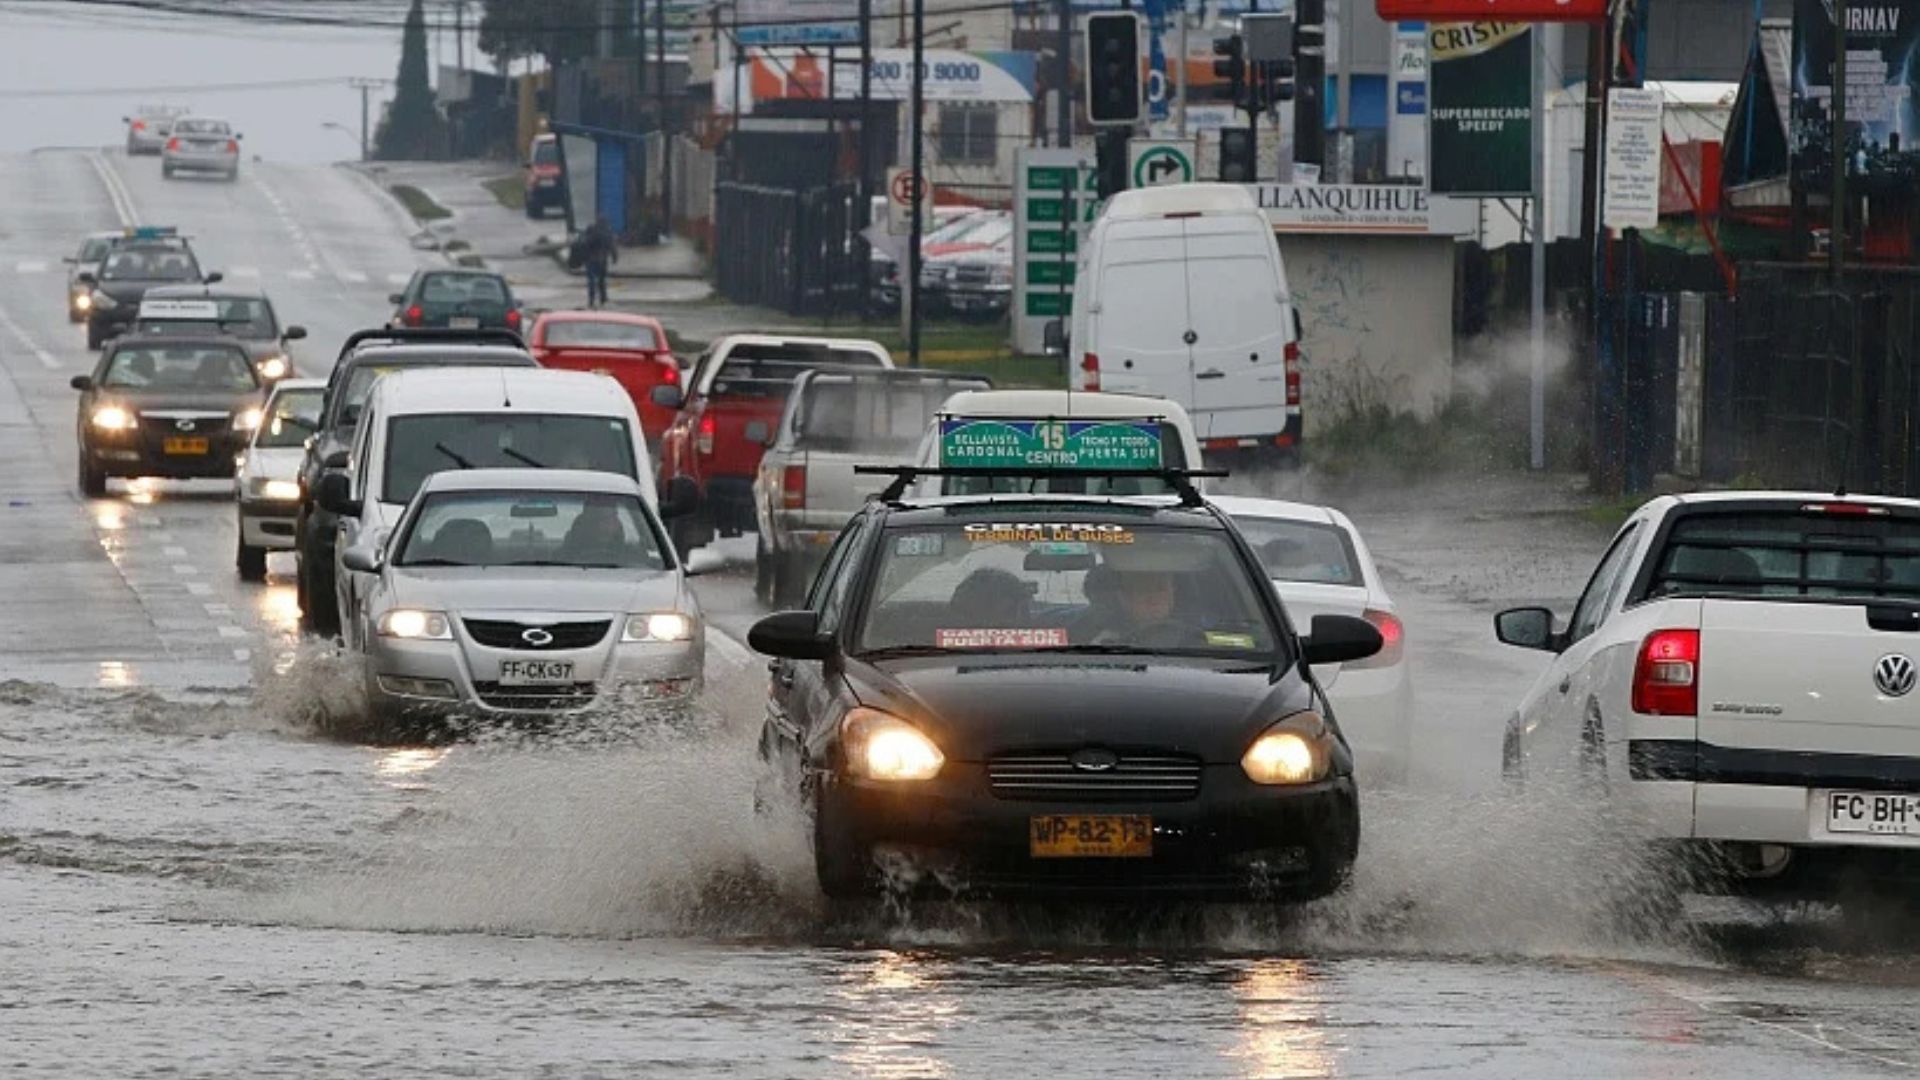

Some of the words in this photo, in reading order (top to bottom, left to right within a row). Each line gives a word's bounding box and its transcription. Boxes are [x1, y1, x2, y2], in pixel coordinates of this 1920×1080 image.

[1432, 107, 1531, 120] SUPERMERCADO
[1458, 120, 1504, 132] SPEEDY
[1258, 186, 1429, 213] LLANQUIHUE
[954, 434, 1020, 446] BELLAVISTA
[1039, 424, 1064, 450] 15
[947, 446, 1024, 457] CARDONAL
[1079, 448, 1127, 459] PUERTA
[1132, 448, 1156, 459] SUR
[1025, 452, 1078, 465] CENTRO
[966, 530, 1049, 542] TERMINAL
[1053, 531, 1076, 542] DE
[1079, 531, 1135, 544] BUSES
[943, 637, 1015, 648] PUERTA
